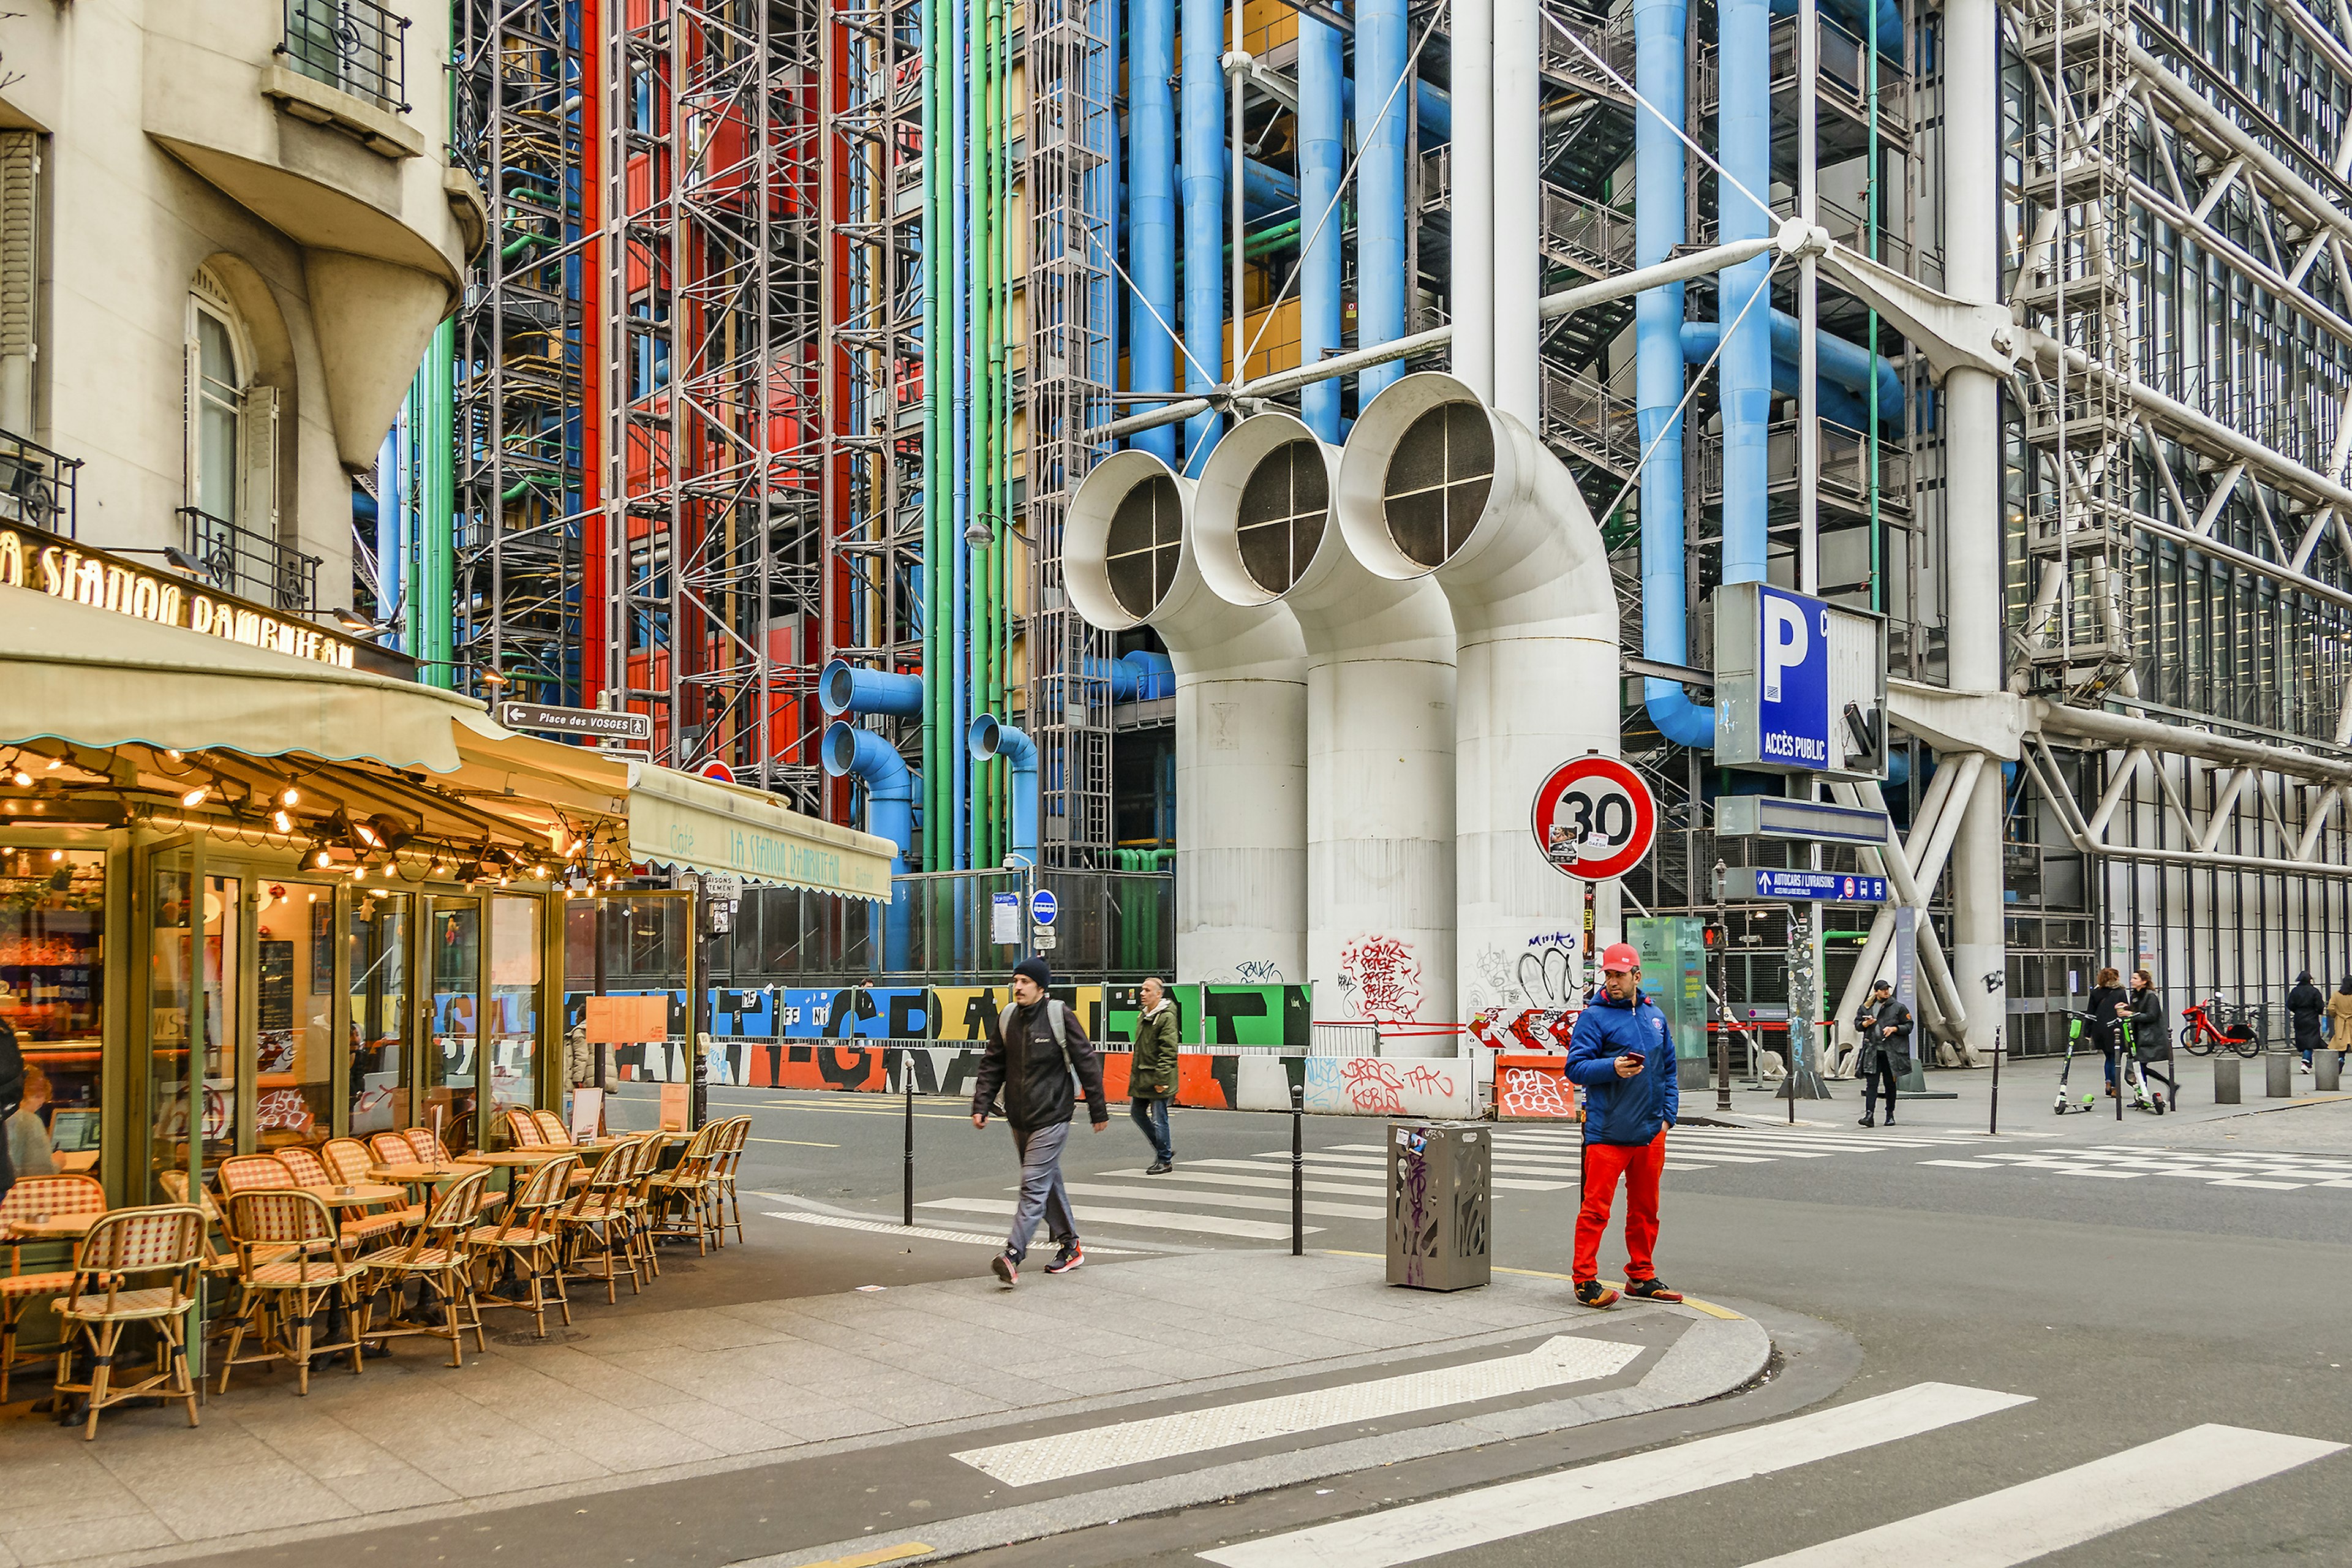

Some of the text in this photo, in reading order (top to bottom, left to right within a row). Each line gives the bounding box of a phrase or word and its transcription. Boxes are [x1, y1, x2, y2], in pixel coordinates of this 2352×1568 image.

[42, 546, 181, 627] STATION
[1764, 594, 1808, 703] P
[539, 712, 628, 730] Place des VOSGES
[1765, 729, 1825, 761] ACCÈS PUBLIC
[670, 824, 694, 856] Café
[1561, 791, 1632, 846] 30
[731, 829, 840, 887] LA STATION RAMBUTEAU
[1774, 873, 1801, 886] AUTOCARS
[1804, 874, 1835, 889] LIVRAISONS
